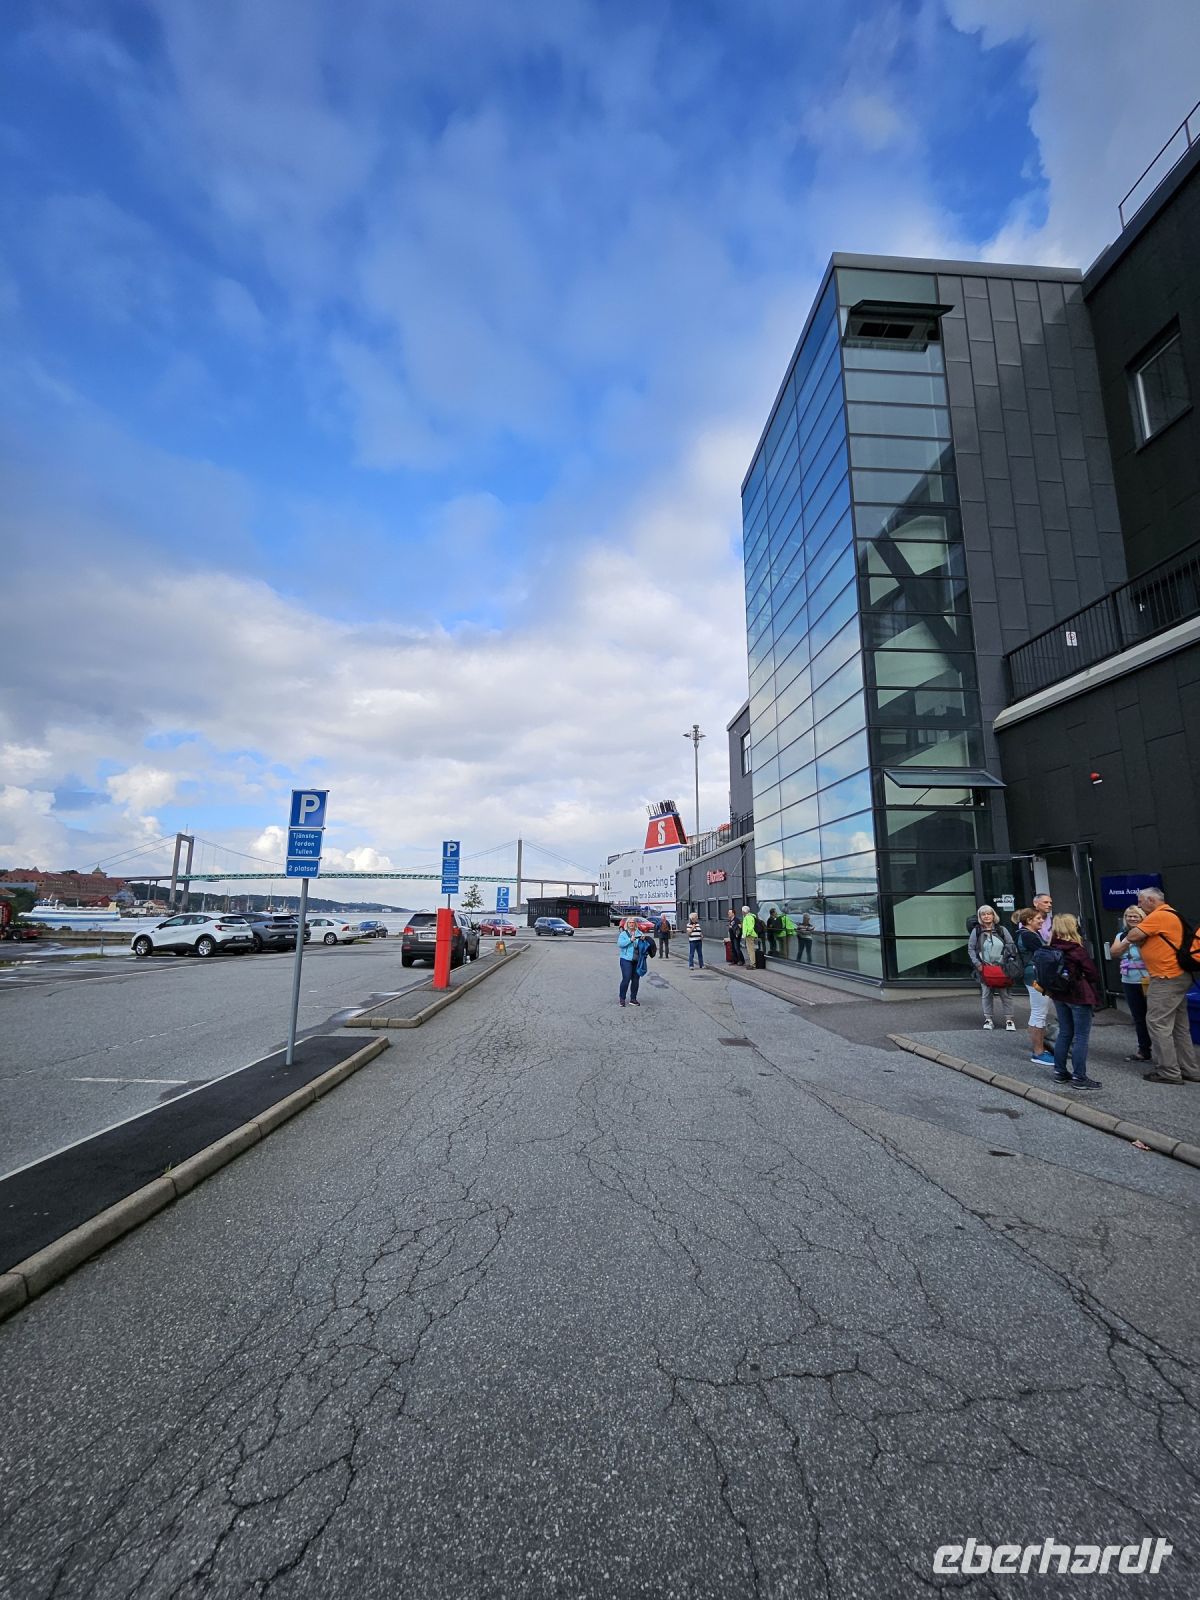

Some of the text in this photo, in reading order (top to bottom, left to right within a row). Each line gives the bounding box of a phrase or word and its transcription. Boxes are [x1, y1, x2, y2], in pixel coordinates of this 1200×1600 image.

[299, 794, 321, 824] P
[657, 821, 665, 844] S
[447, 842, 457, 857] P
[294, 865, 317, 873] platser
[633, 877, 669, 889] Connecting
[501, 887, 507, 896] P
[648, 891, 673, 899] Sustainable
